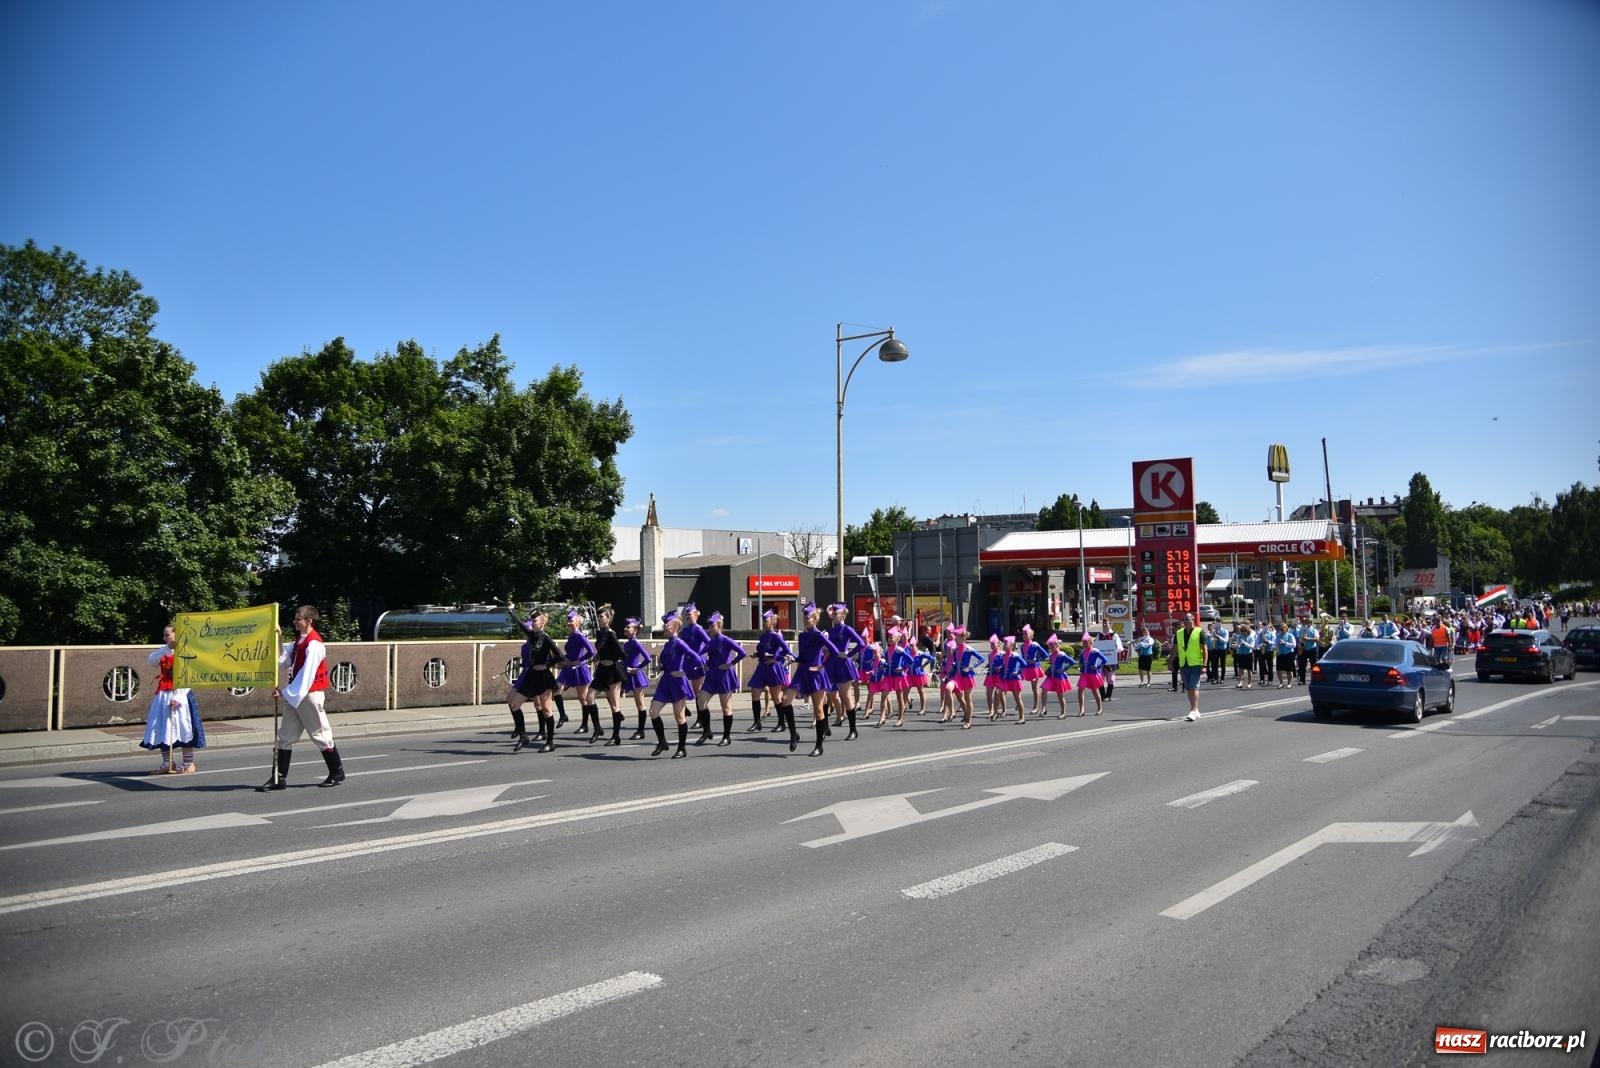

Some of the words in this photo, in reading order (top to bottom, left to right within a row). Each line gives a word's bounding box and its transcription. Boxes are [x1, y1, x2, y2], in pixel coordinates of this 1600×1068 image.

[1151, 470, 1181, 505] K
[1258, 543, 1297, 553] CIRCLE
[1166, 550, 1190, 561] 5.79
[1167, 562, 1190, 573] 5.72
[1167, 574, 1190, 585] 6.14
[1167, 588, 1191, 599] 6.07
[1168, 600, 1191, 611] 2.79
